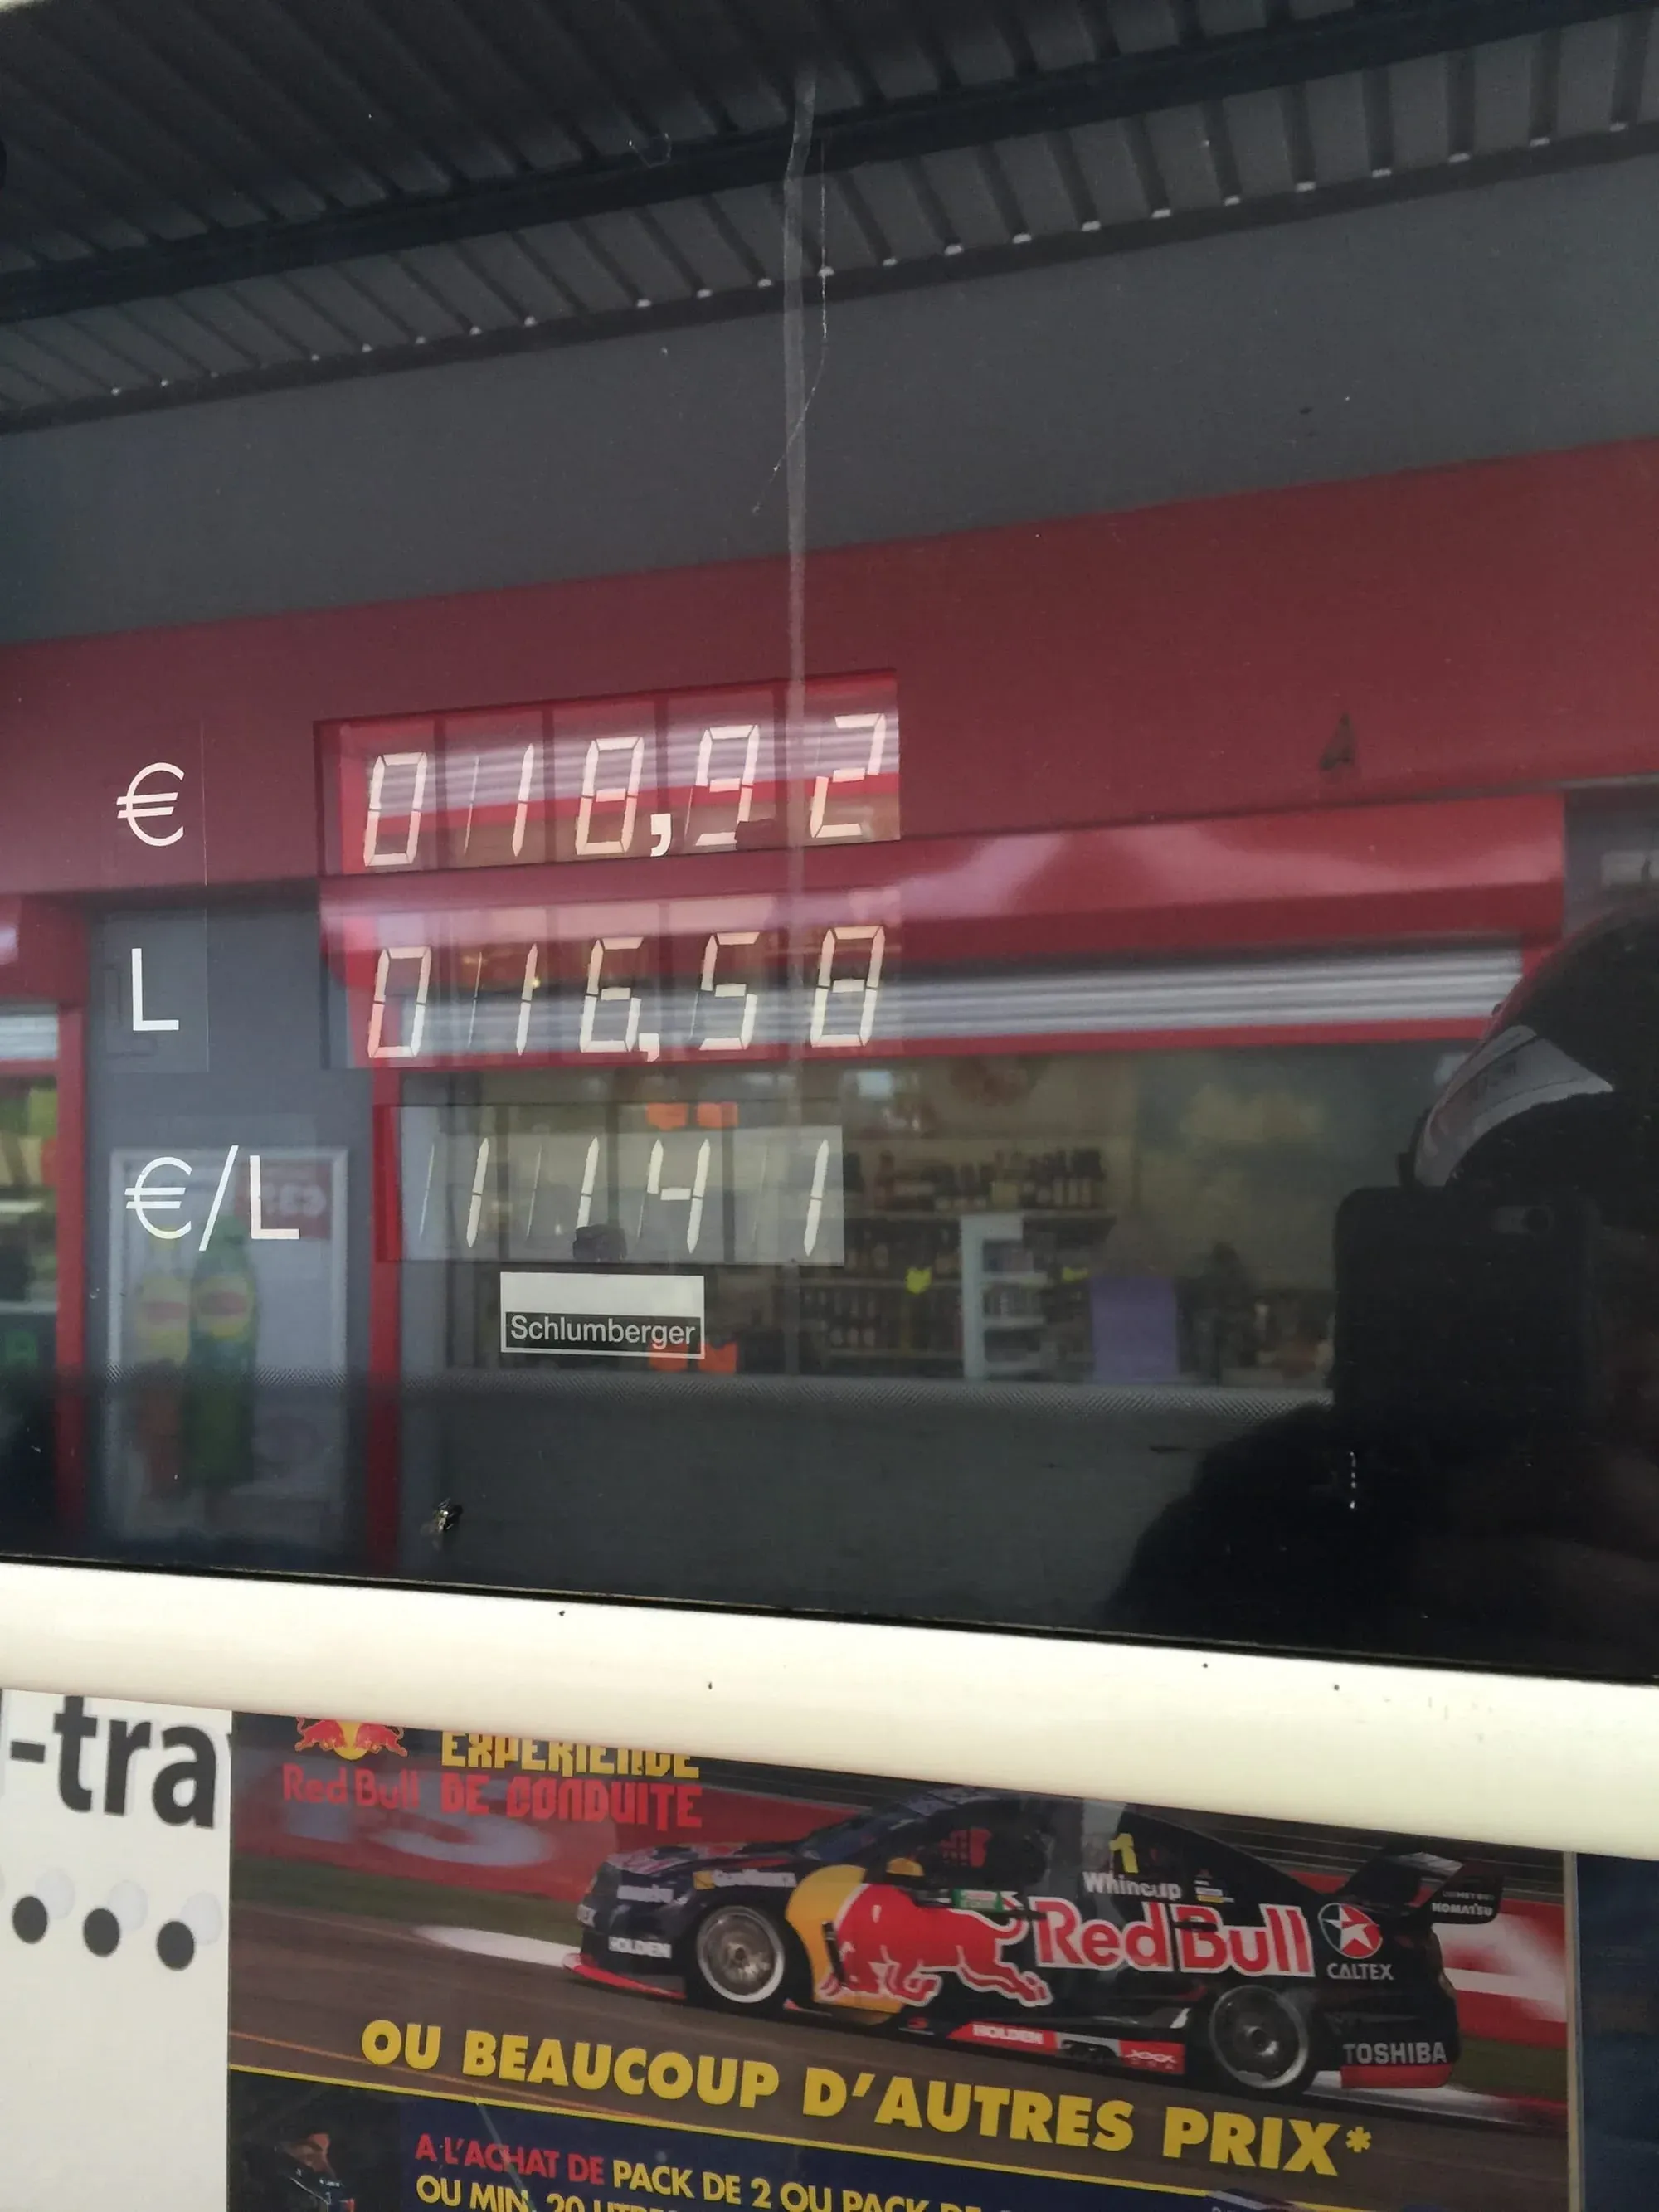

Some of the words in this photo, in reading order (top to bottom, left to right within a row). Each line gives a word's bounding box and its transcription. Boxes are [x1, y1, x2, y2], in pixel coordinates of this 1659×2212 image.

[116, 762, 184, 847] €
[131, 948, 179, 1031] L
[124, 1144, 300, 1252] €/L
[510, 1315, 696, 1349] Schlumberger
[0, 1689, 231, 1830] -tra
[440, 1772, 489, 1816] DE
[507, 1776, 703, 1831] CONDUITE
[1108, 1833, 1139, 1874] 1
[1082, 1870, 1183, 1901] Whincup
[1431, 1902, 1493, 1916] KOMATSU
[1327, 1963, 1394, 1981] CALTEX
[361, 2019, 441, 2070] OU
[462, 2030, 779, 2109] BEAUCOUP
[1342, 2042, 1447, 2064] TOSHIBA
[416, 2133, 438, 2162] A
[567, 2153, 606, 2185] DE
[612, 2160, 694, 2198] PACK
[703, 2171, 741, 2205] DE
[750, 2178, 772, 2209] 2
[780, 2182, 832, 2212] OU
[416, 2175, 461, 2207] OU
